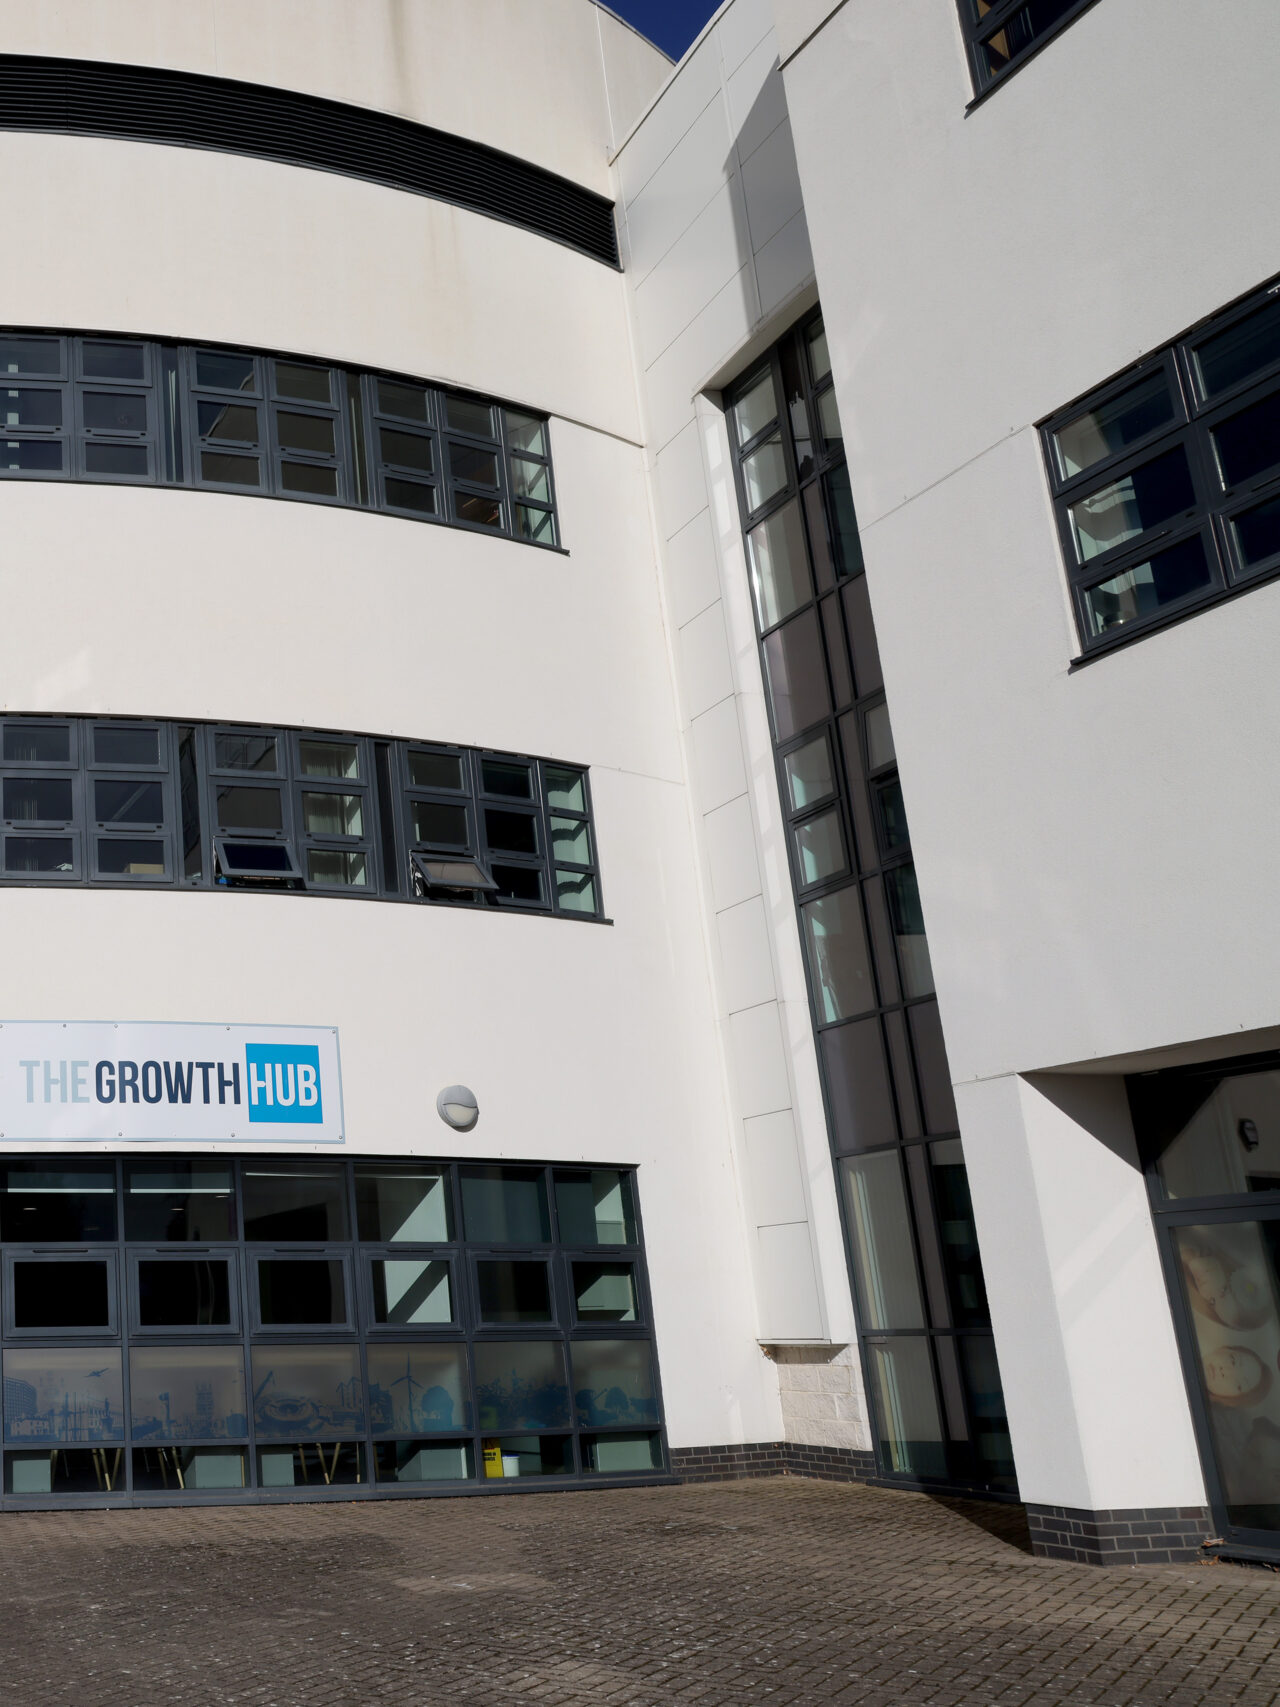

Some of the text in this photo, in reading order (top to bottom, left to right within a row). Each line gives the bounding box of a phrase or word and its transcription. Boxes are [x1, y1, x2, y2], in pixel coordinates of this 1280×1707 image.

[18, 1060, 319, 1107] THE GROWTH HUB
